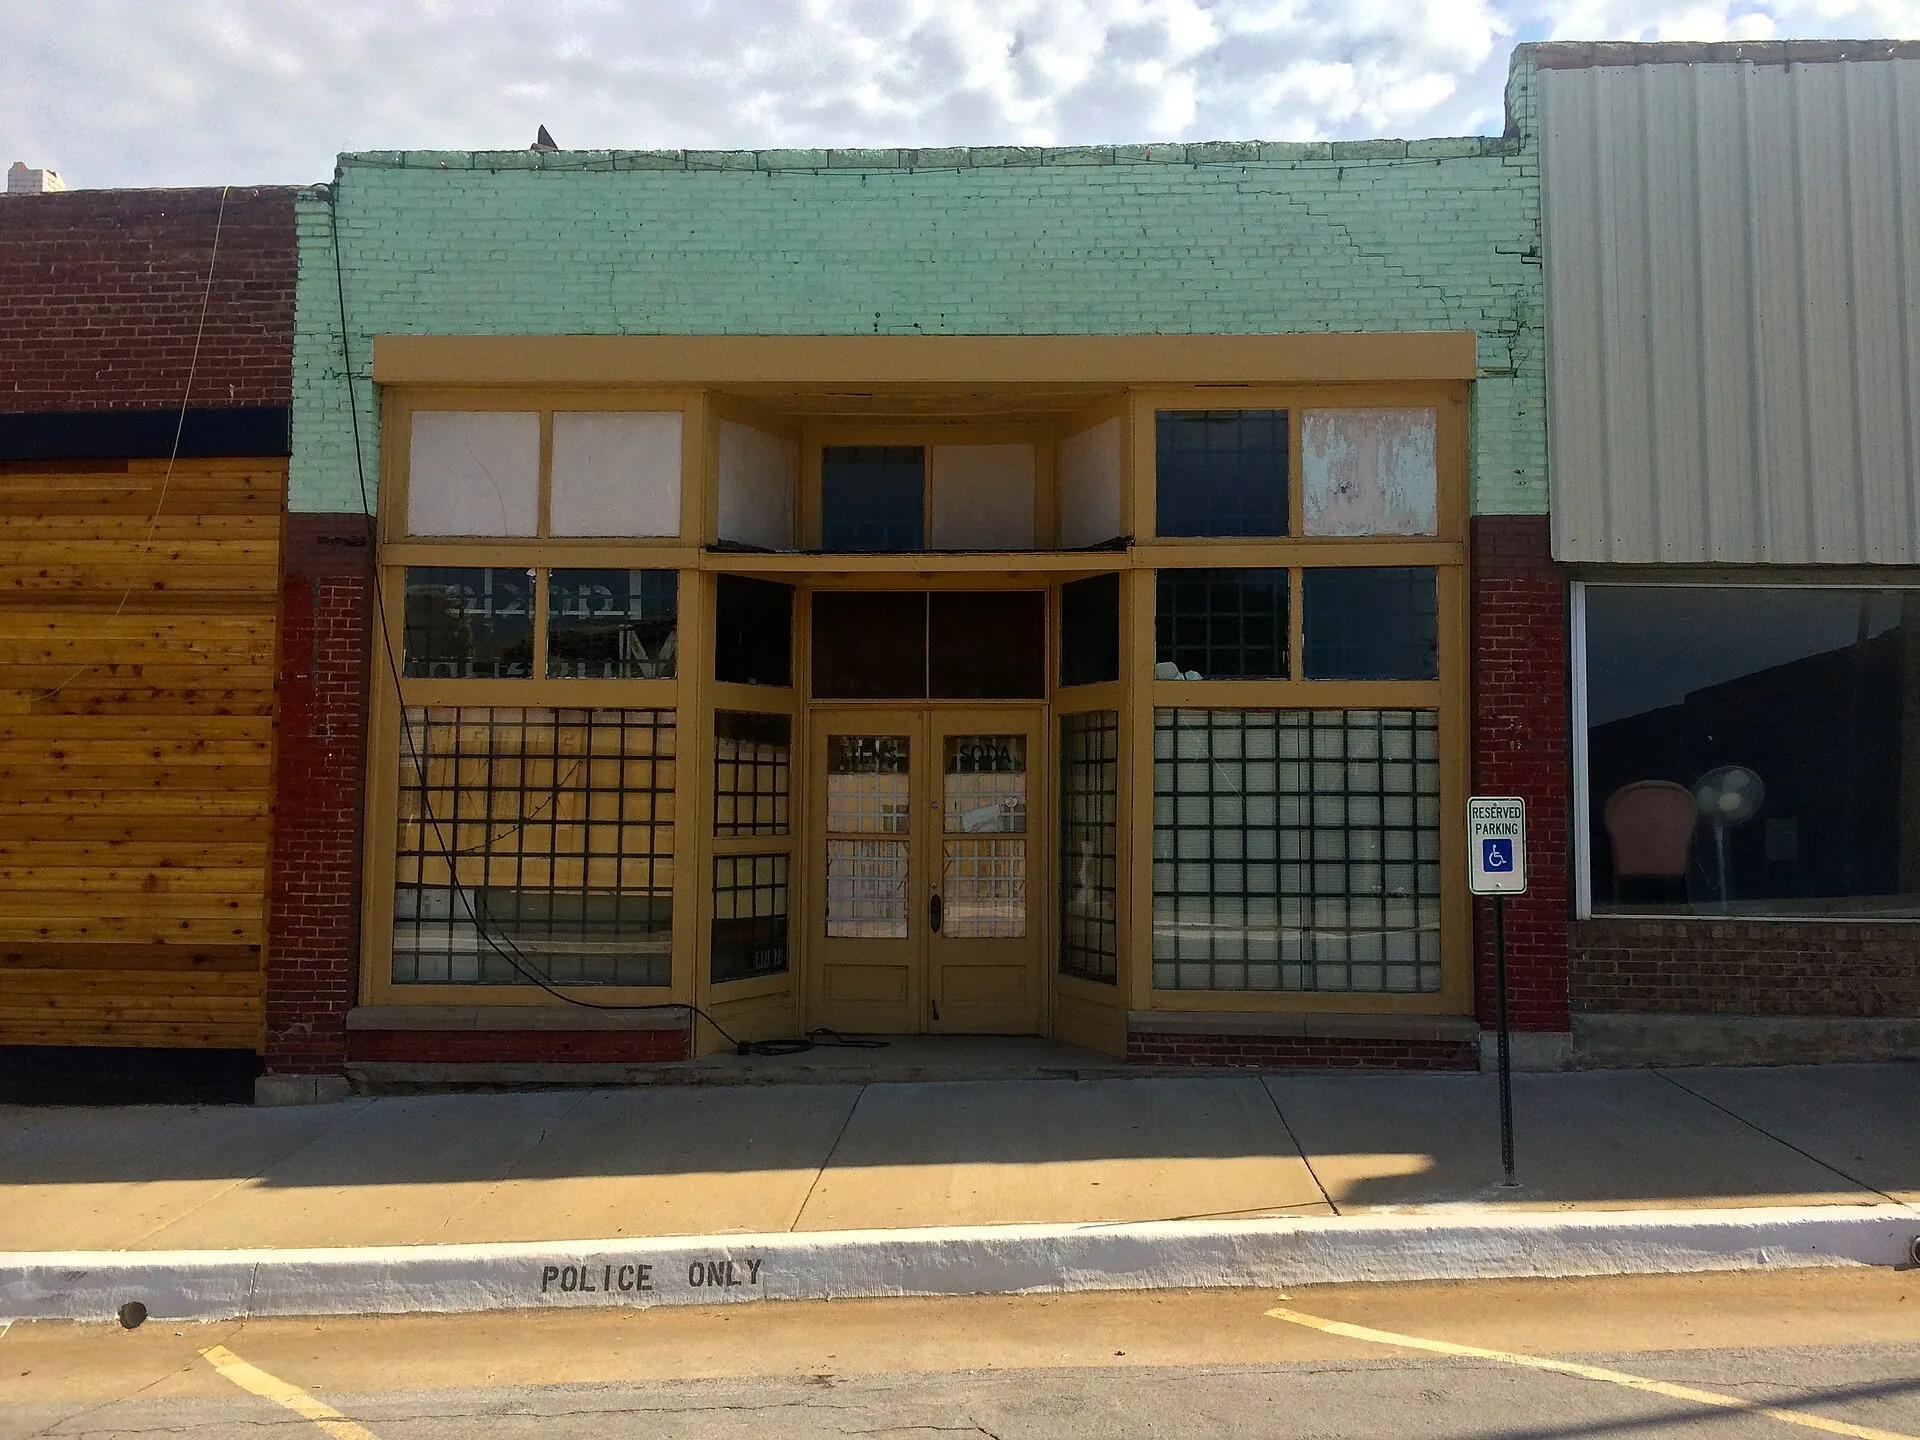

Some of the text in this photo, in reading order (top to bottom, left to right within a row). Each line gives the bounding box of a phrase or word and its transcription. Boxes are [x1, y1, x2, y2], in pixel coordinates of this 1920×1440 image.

[959, 744, 1012, 764] SODA
[1472, 806, 1521, 819] RESERVED
[1475, 823, 1518, 835] PARKING
[541, 1258, 763, 1293] POLICE ONLY
